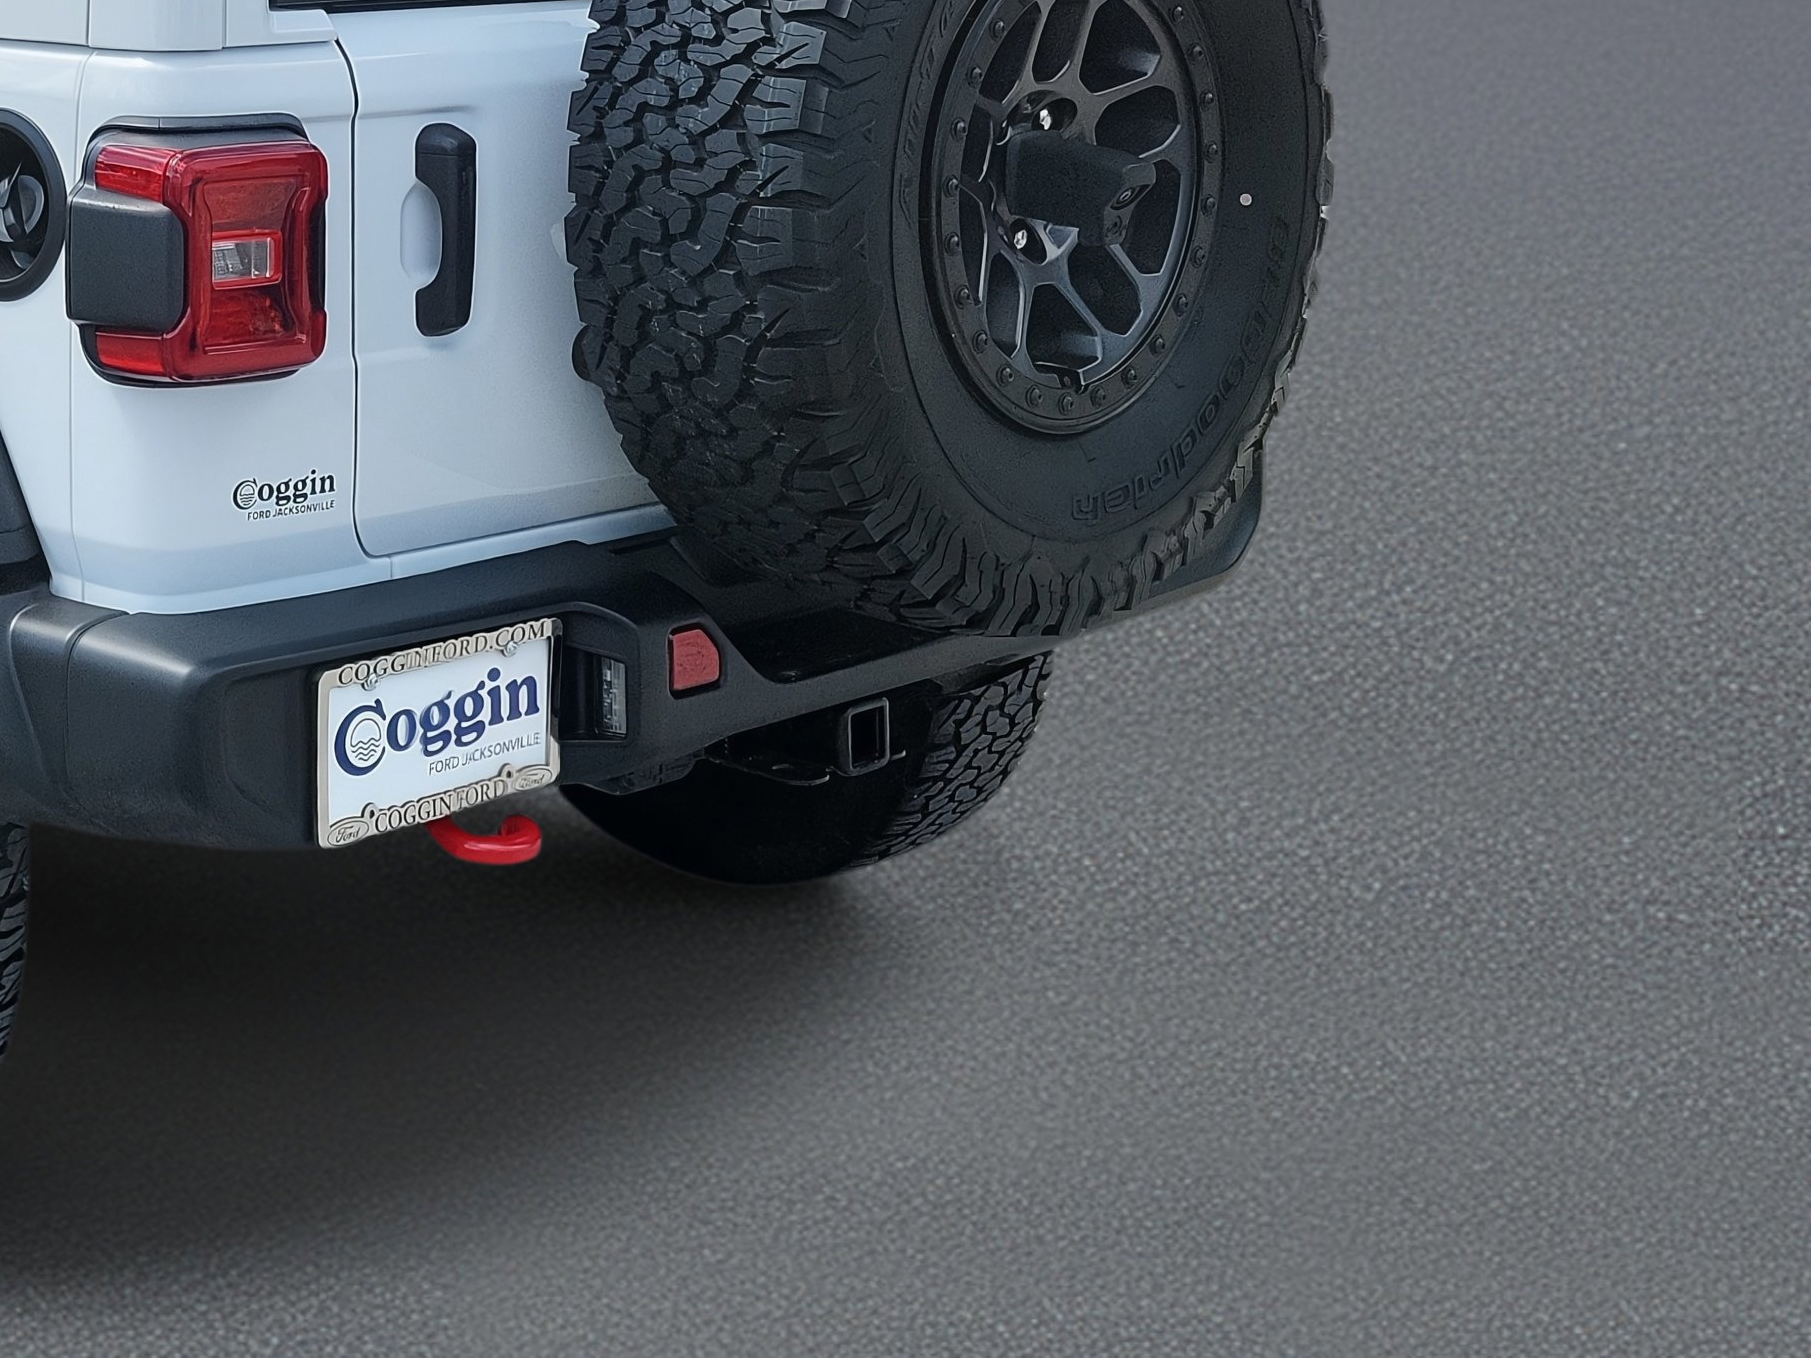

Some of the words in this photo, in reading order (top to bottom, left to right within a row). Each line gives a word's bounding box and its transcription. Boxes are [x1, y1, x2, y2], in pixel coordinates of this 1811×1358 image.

[232, 469, 336, 510] Coggin
[247, 509, 271, 521] FORD
[272, 499, 335, 518] JACKSONVILLE
[338, 619, 547, 685] COGGINFORD.COM
[333, 667, 540, 776] Coggin
[428, 756, 460, 776] FORD
[461, 732, 542, 768] JACKSONVILLE
[374, 792, 453, 834] COGGIN
[457, 778, 508, 810] FORD
[334, 825, 361, 843] Ford
